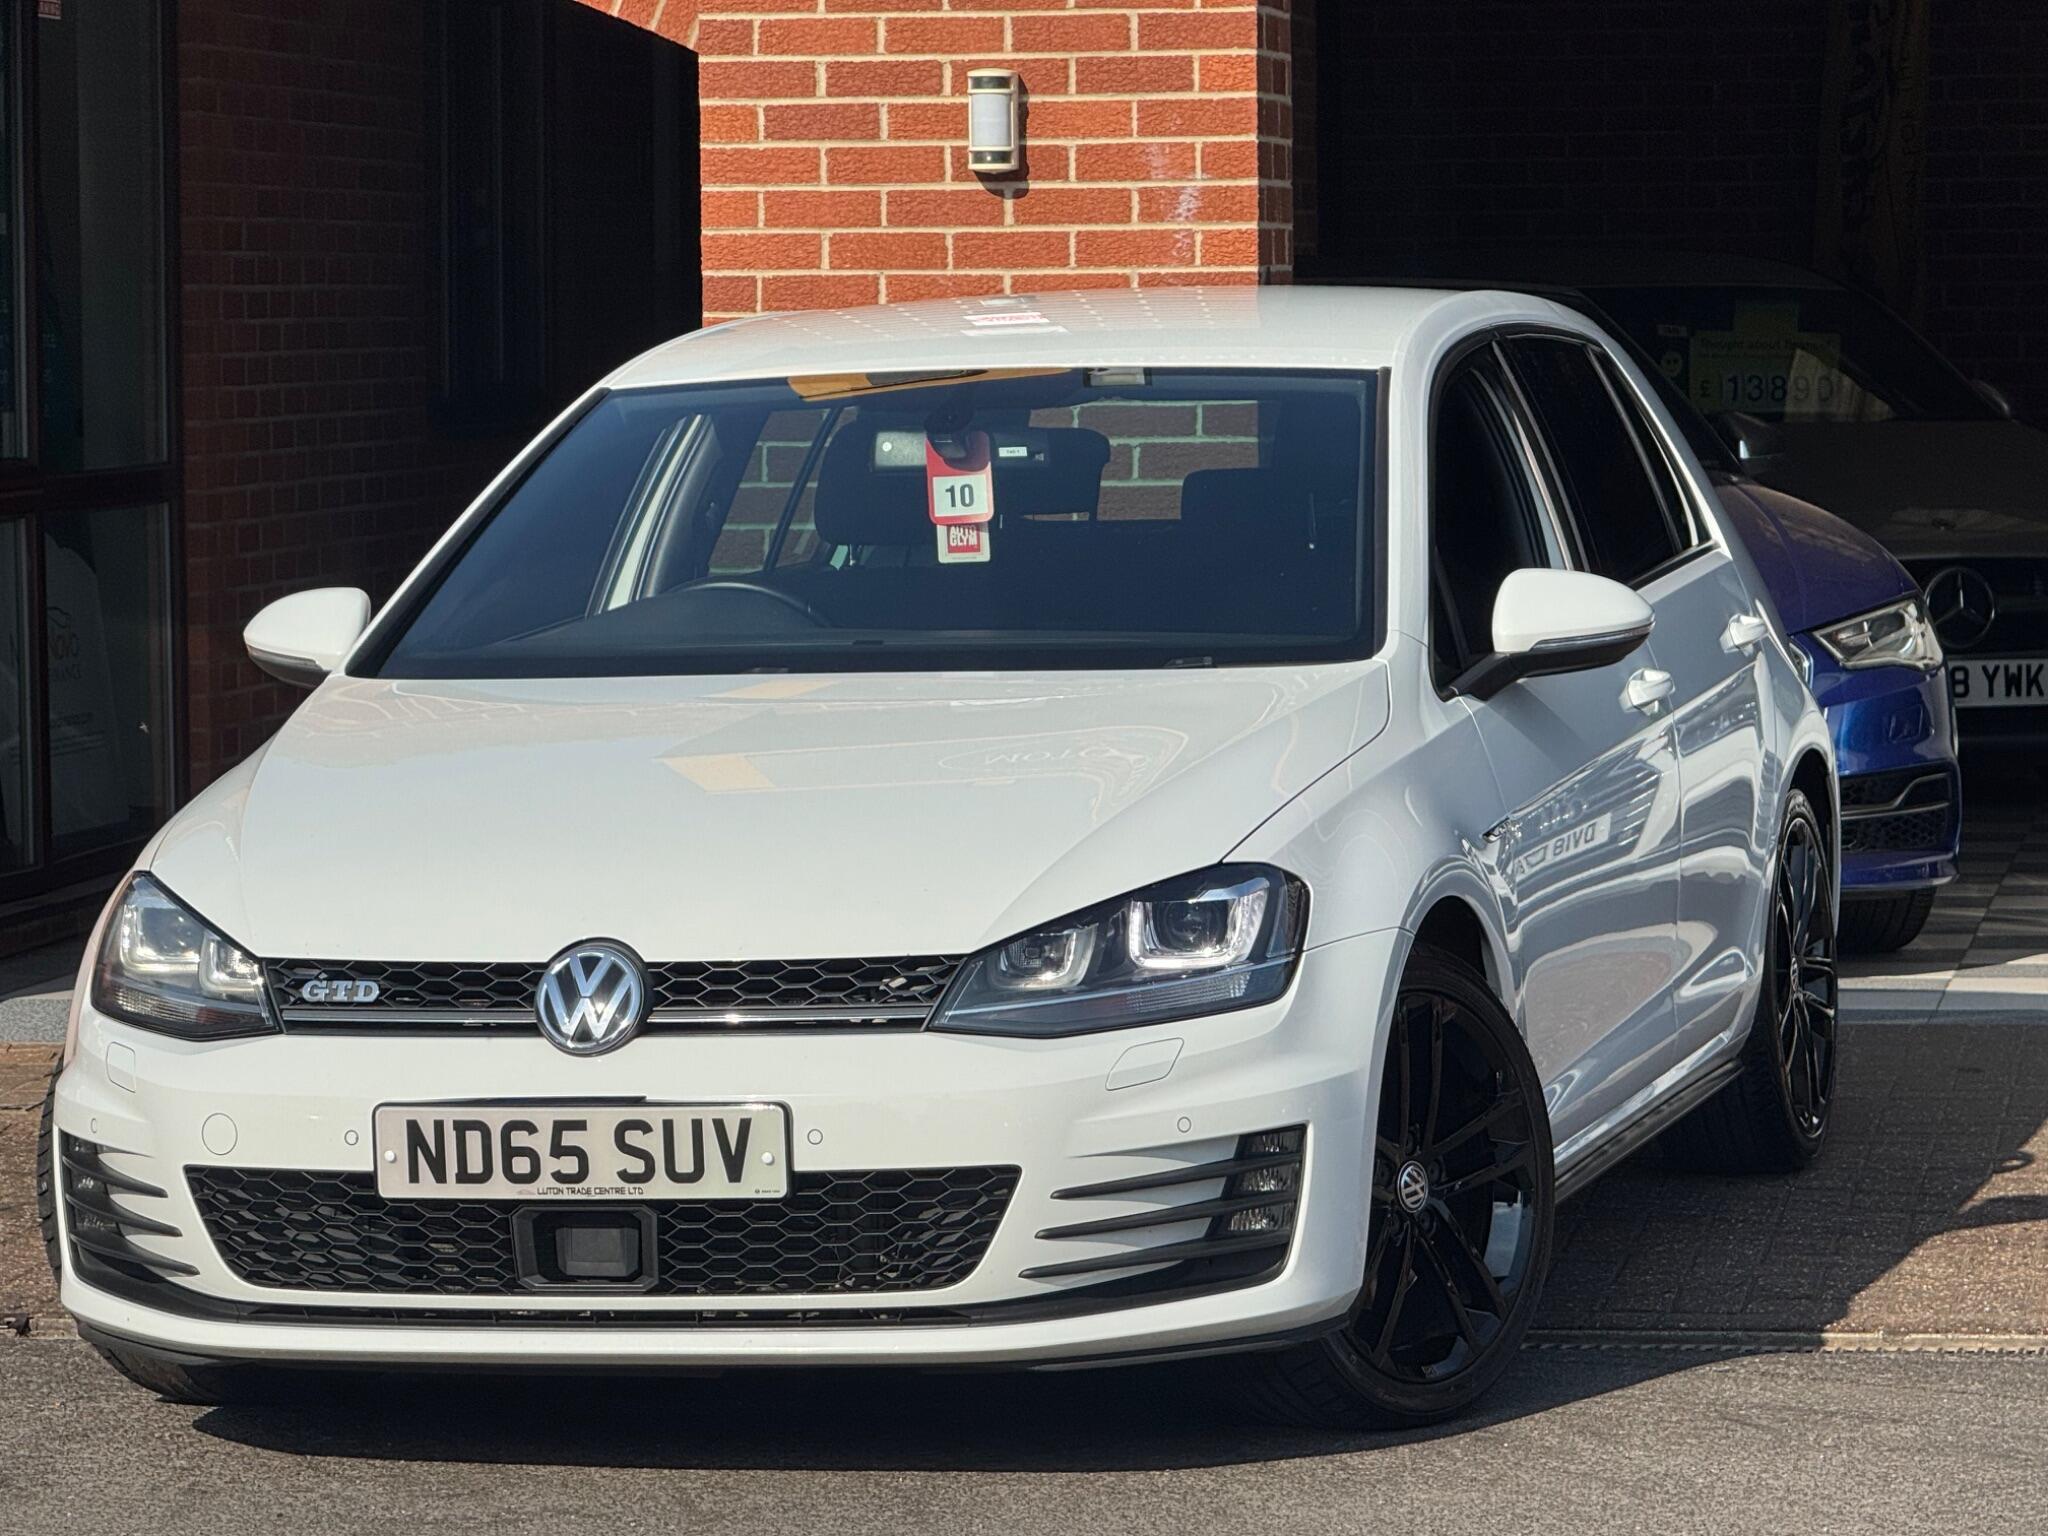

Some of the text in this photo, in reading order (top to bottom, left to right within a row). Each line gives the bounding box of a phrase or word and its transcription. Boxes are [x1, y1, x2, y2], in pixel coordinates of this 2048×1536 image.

[1727, 374, 1834, 402] 13890
[945, 484, 974, 507] 10
[1981, 663, 2045, 699] YWK
[301, 978, 381, 1003] GTD
[405, 1117, 753, 1185] ND65 SUV
[536, 1186, 644, 1196] LUTON TRADE CENTRE LTD
